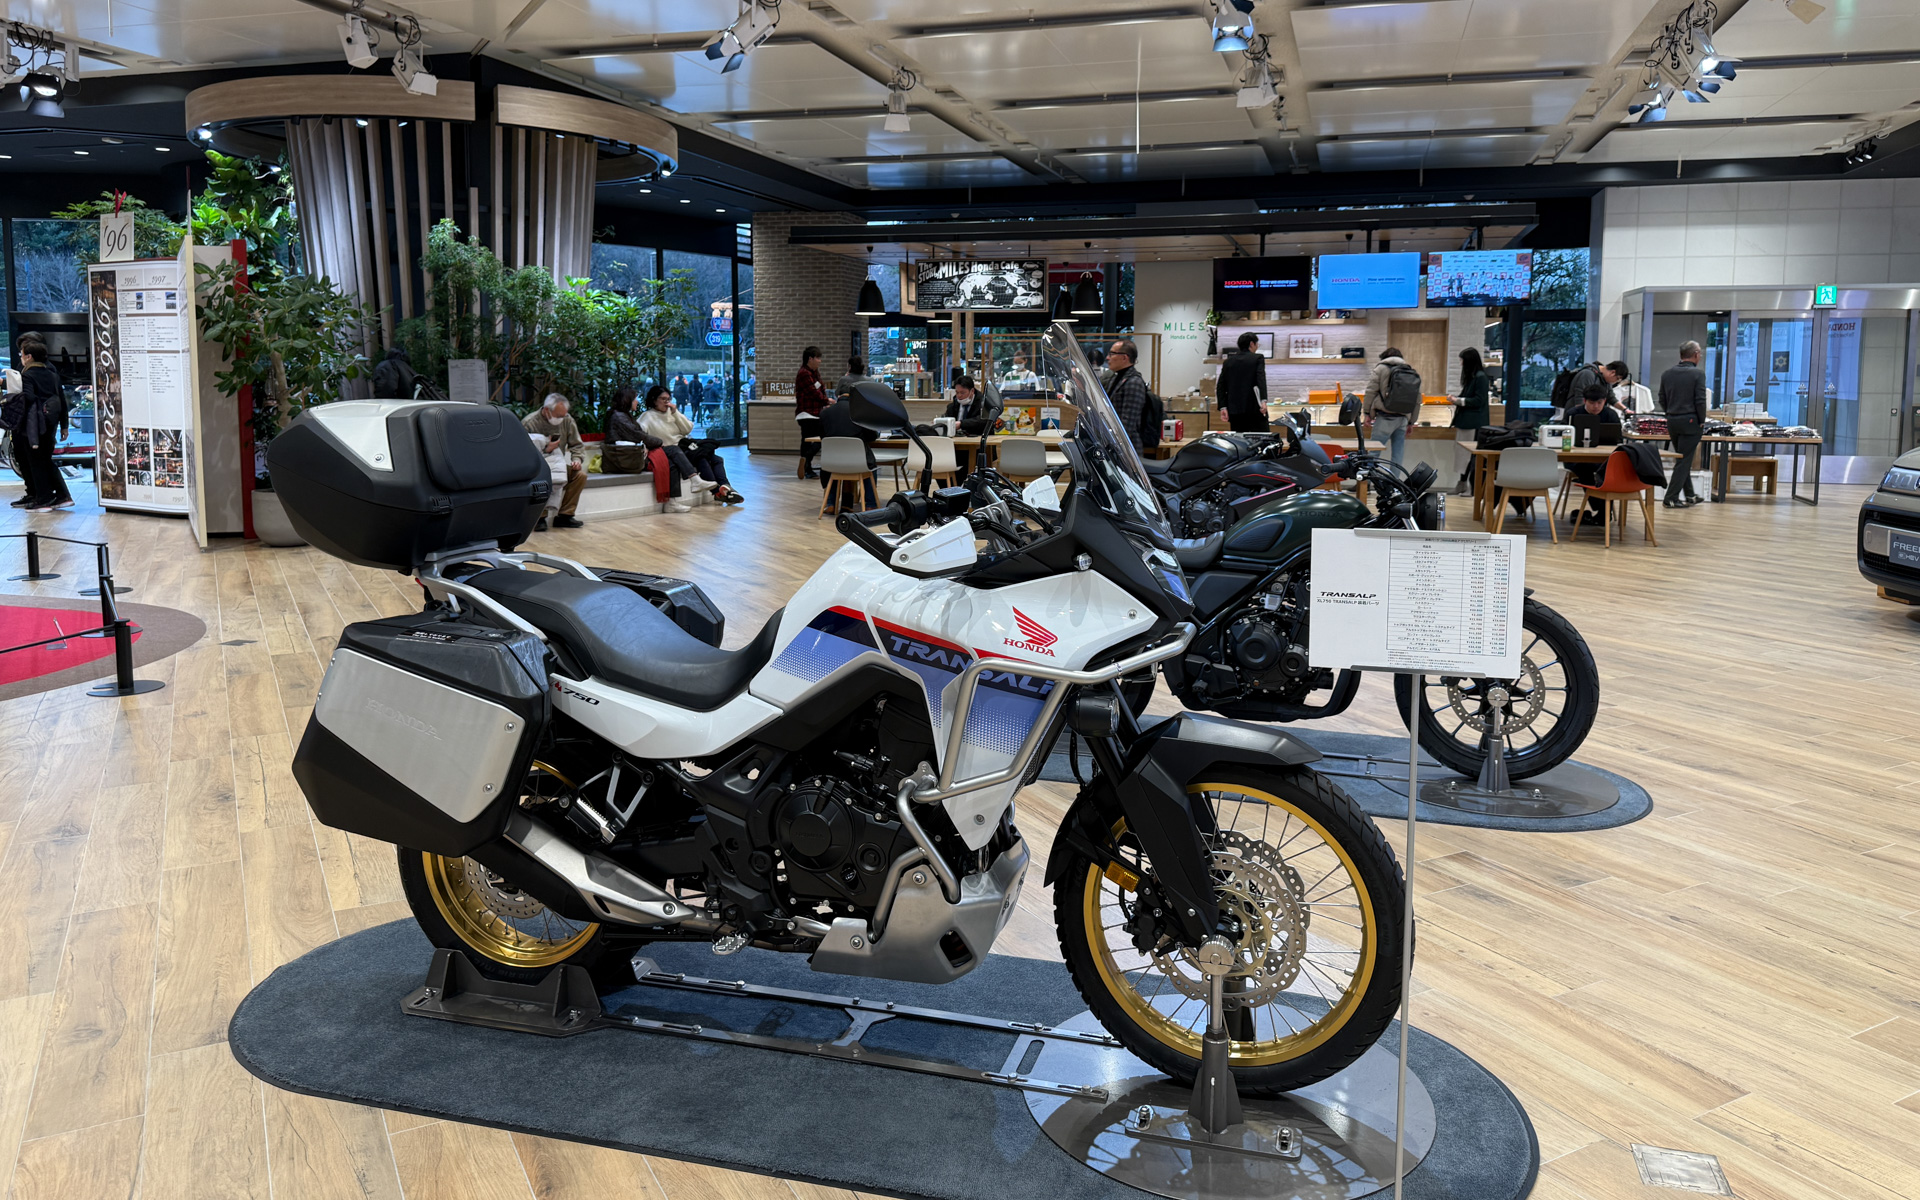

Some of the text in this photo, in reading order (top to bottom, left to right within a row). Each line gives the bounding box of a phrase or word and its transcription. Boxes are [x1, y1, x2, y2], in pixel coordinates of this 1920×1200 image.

[104, 222, 129, 258] '96
[918, 262, 932, 272] The
[939, 262, 970, 279] MILES
[971, 262, 999, 273] Honda
[1000, 261, 1019, 270] Cafe
[1164, 322, 1205, 331] MILES
[1298, 510, 1343, 518] HONDA
[1893, 541, 1920, 554] FREE
[1320, 591, 1377, 599] TRANSALP
[1003, 637, 1056, 658] HONDA
[364, 697, 442, 740] HONDA
